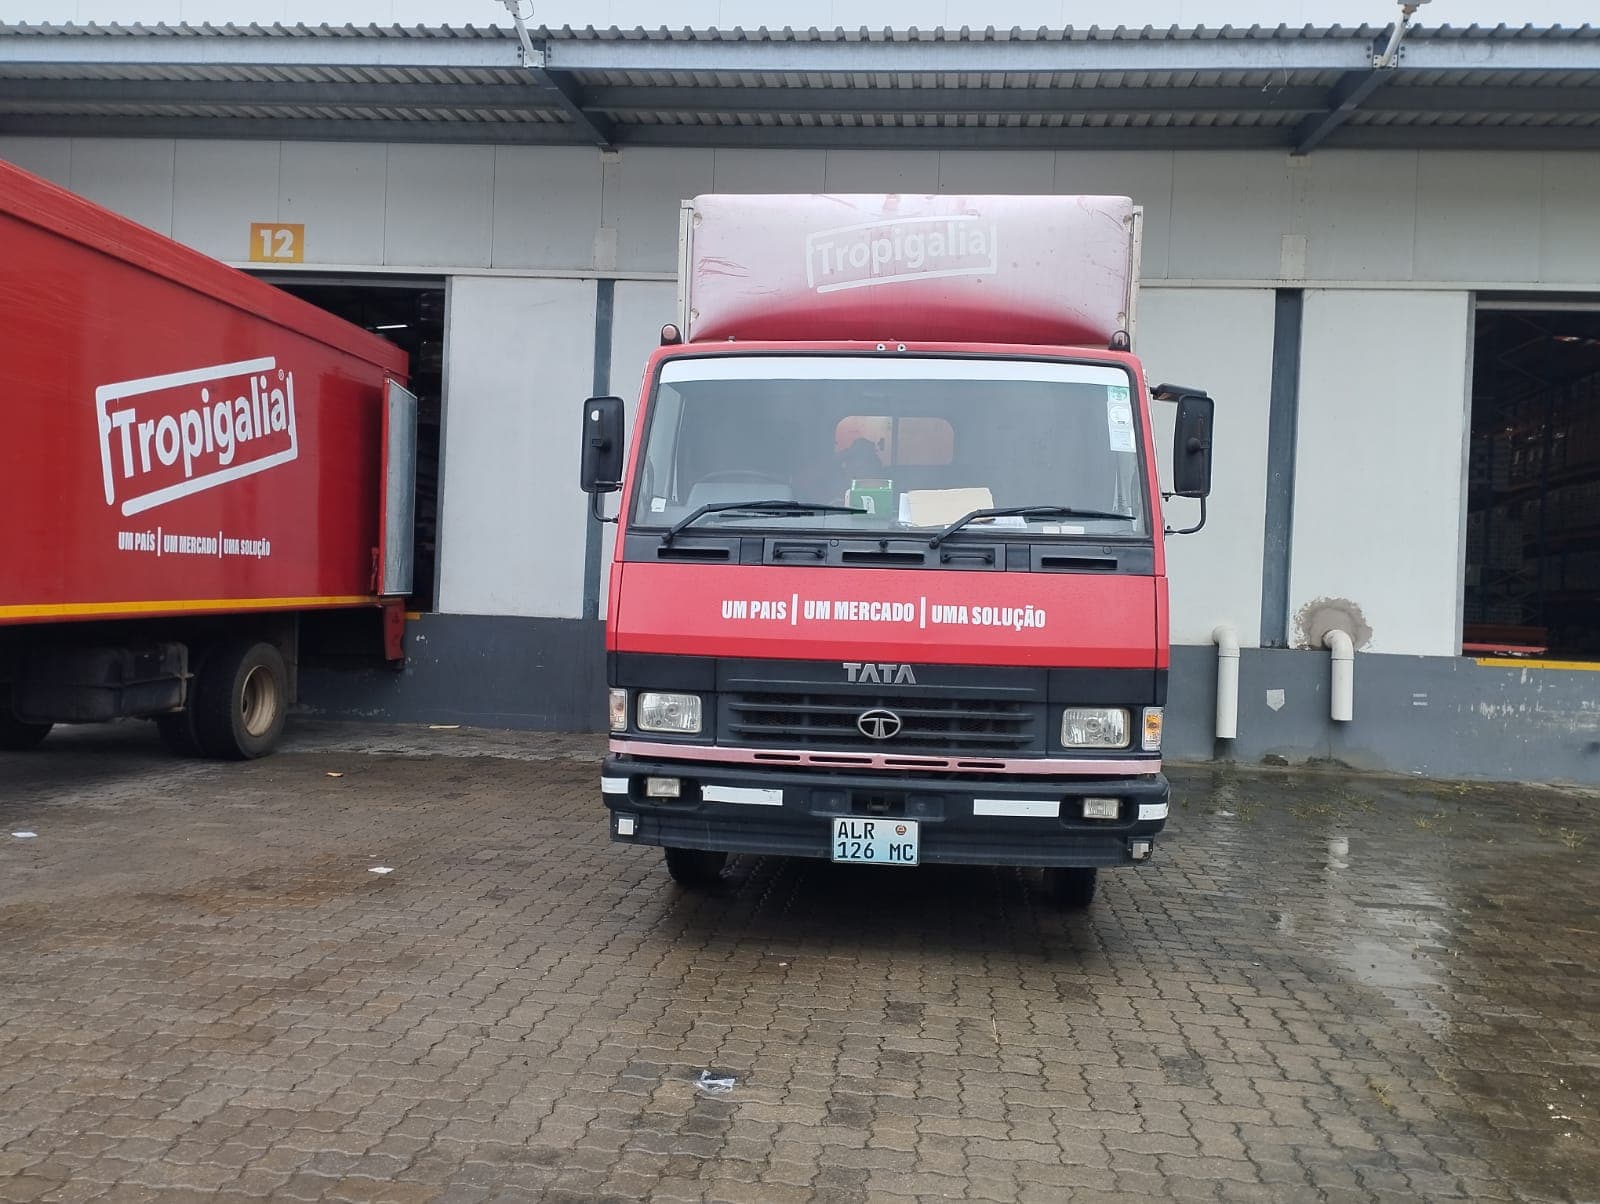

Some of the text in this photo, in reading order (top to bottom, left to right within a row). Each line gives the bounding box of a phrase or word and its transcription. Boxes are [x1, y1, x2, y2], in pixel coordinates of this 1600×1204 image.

[260, 229, 294, 257] 12
[815, 221, 987, 274] Tropigalia
[118, 530, 271, 559] UM PAÍS UM MERCADO UMA SOLUÇÃO
[721, 600, 1047, 631] UM PAIS UM MERCADO UMA SOLUÇÃO
[842, 662, 917, 685] TATA
[838, 821, 875, 840] ALR
[837, 841, 914, 861] 126 MC
